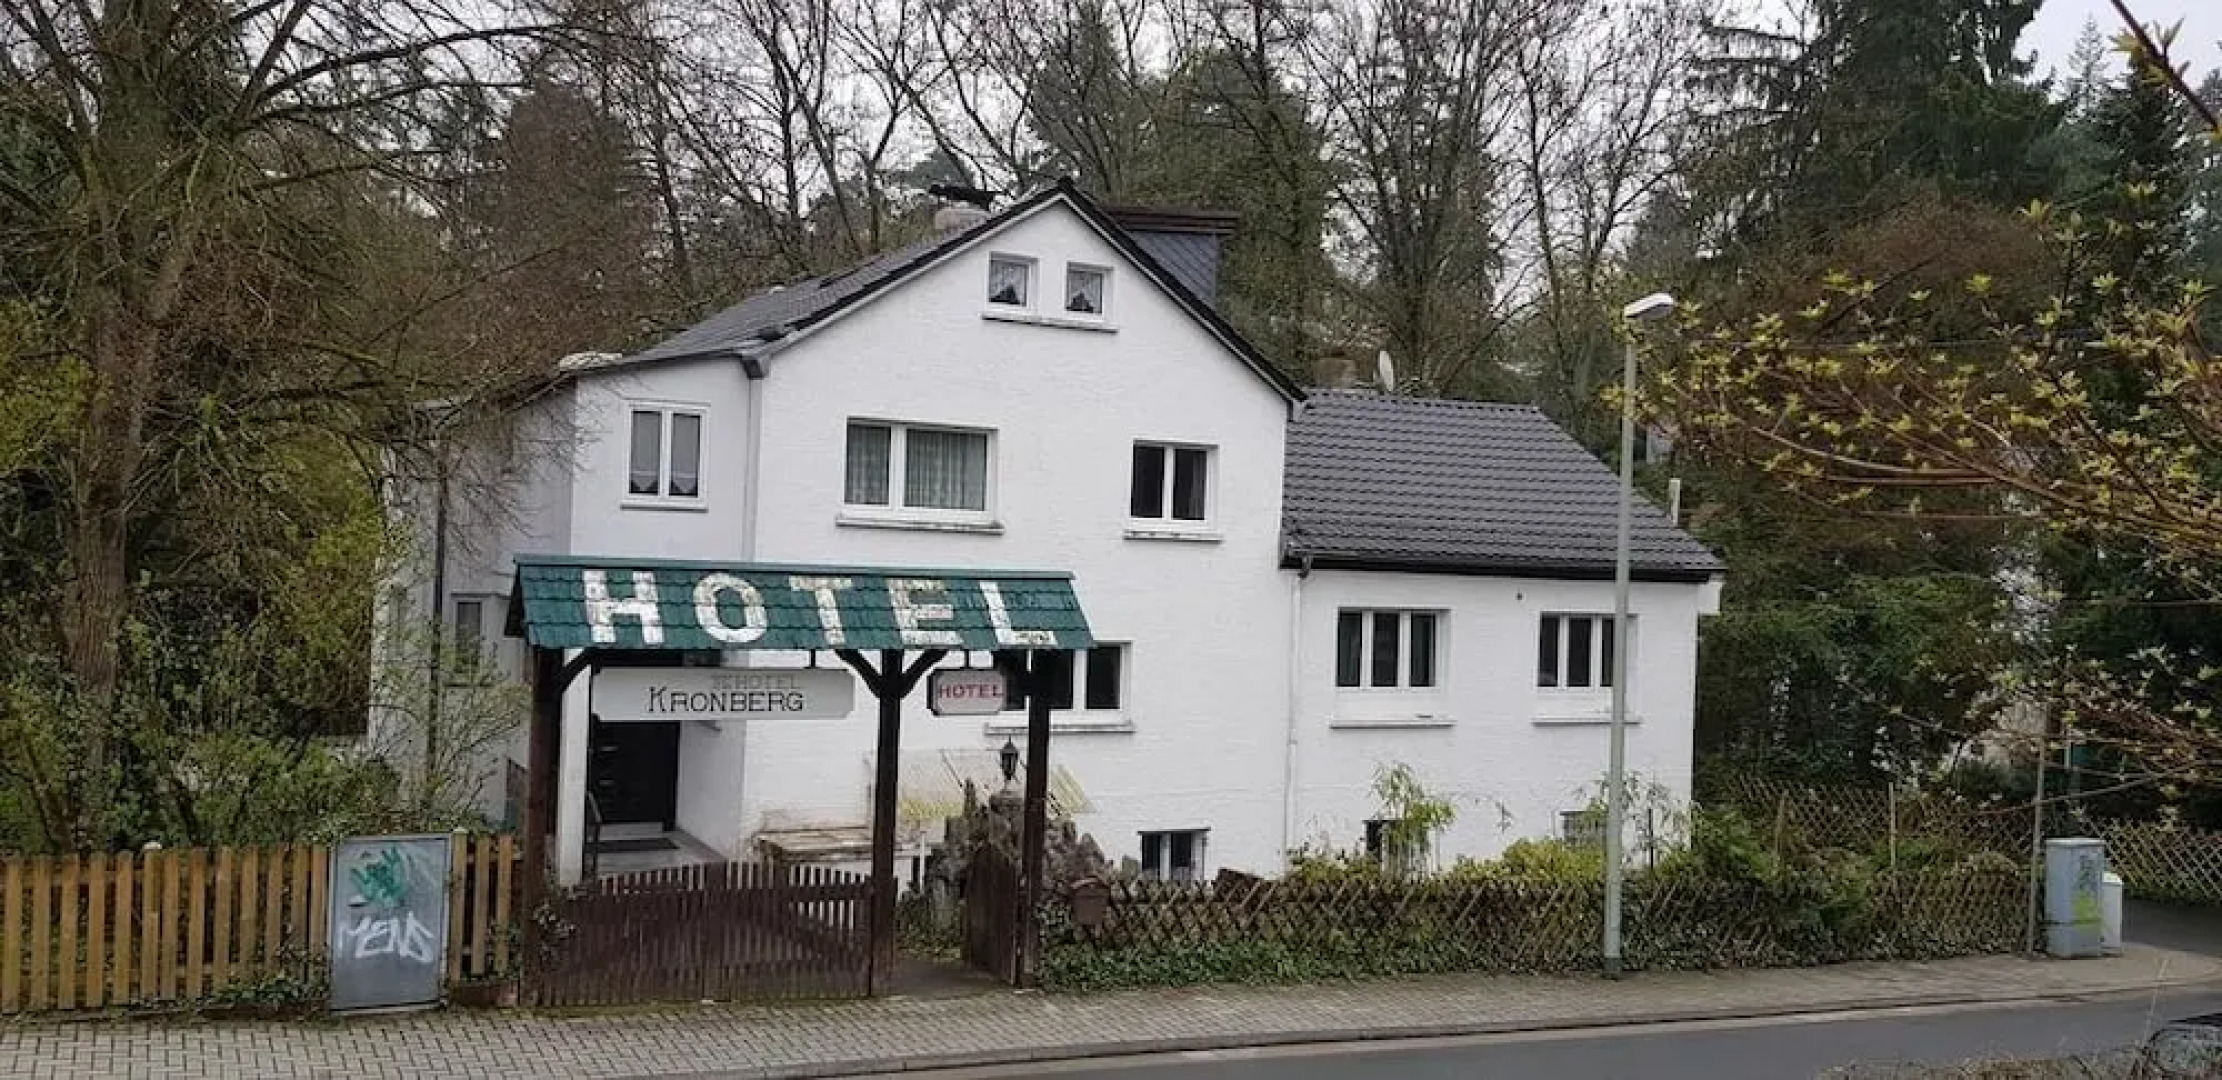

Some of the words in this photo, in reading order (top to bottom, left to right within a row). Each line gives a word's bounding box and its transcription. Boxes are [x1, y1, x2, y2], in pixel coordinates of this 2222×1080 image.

[583, 570, 1059, 646] HOTEL
[649, 686, 804, 712] KRONBERG
[939, 683, 1005, 699] HOTEL
